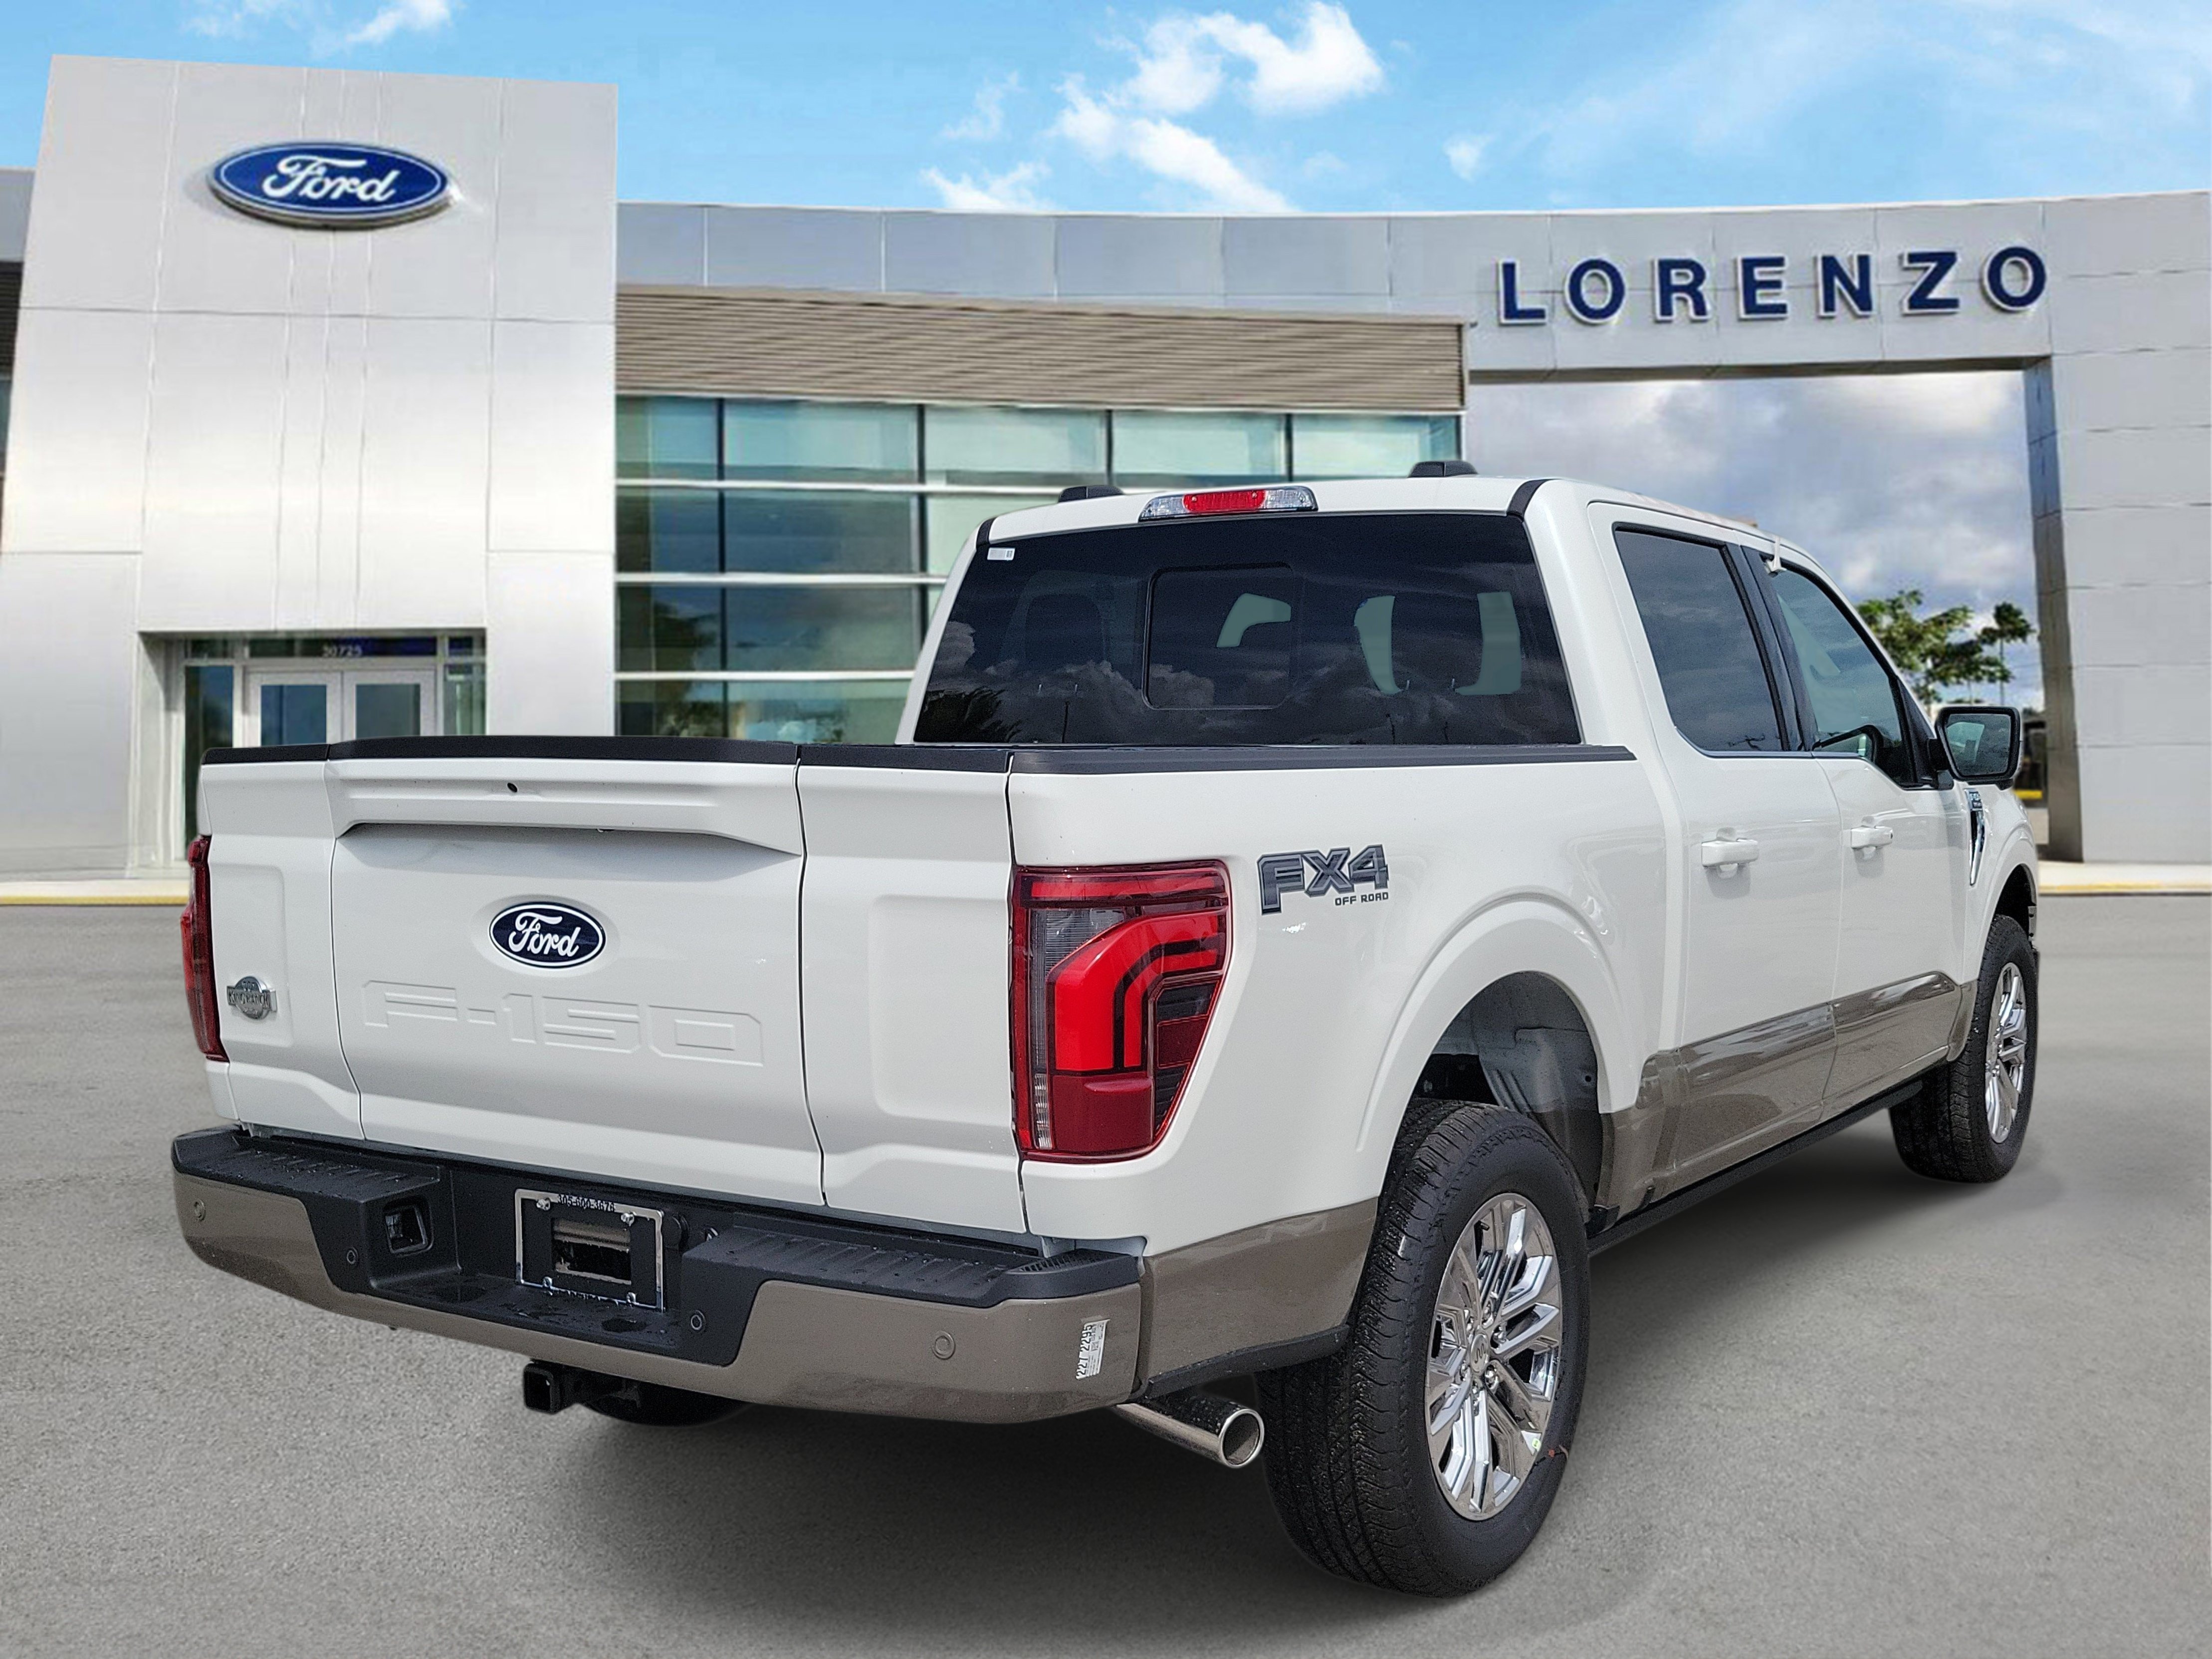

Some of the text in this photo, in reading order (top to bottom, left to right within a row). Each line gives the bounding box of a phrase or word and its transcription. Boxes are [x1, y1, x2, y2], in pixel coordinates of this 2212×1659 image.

[262, 154, 400, 201] Ford
[1500, 246, 2048, 322] LORENZO
[1257, 844, 1389, 915] FX4
[1334, 892, 1389, 906] OFF ROAD
[509, 912, 581, 957] Ford
[362, 979, 764, 1066] F-150
[1080, 1324, 1092, 1352] 2295
